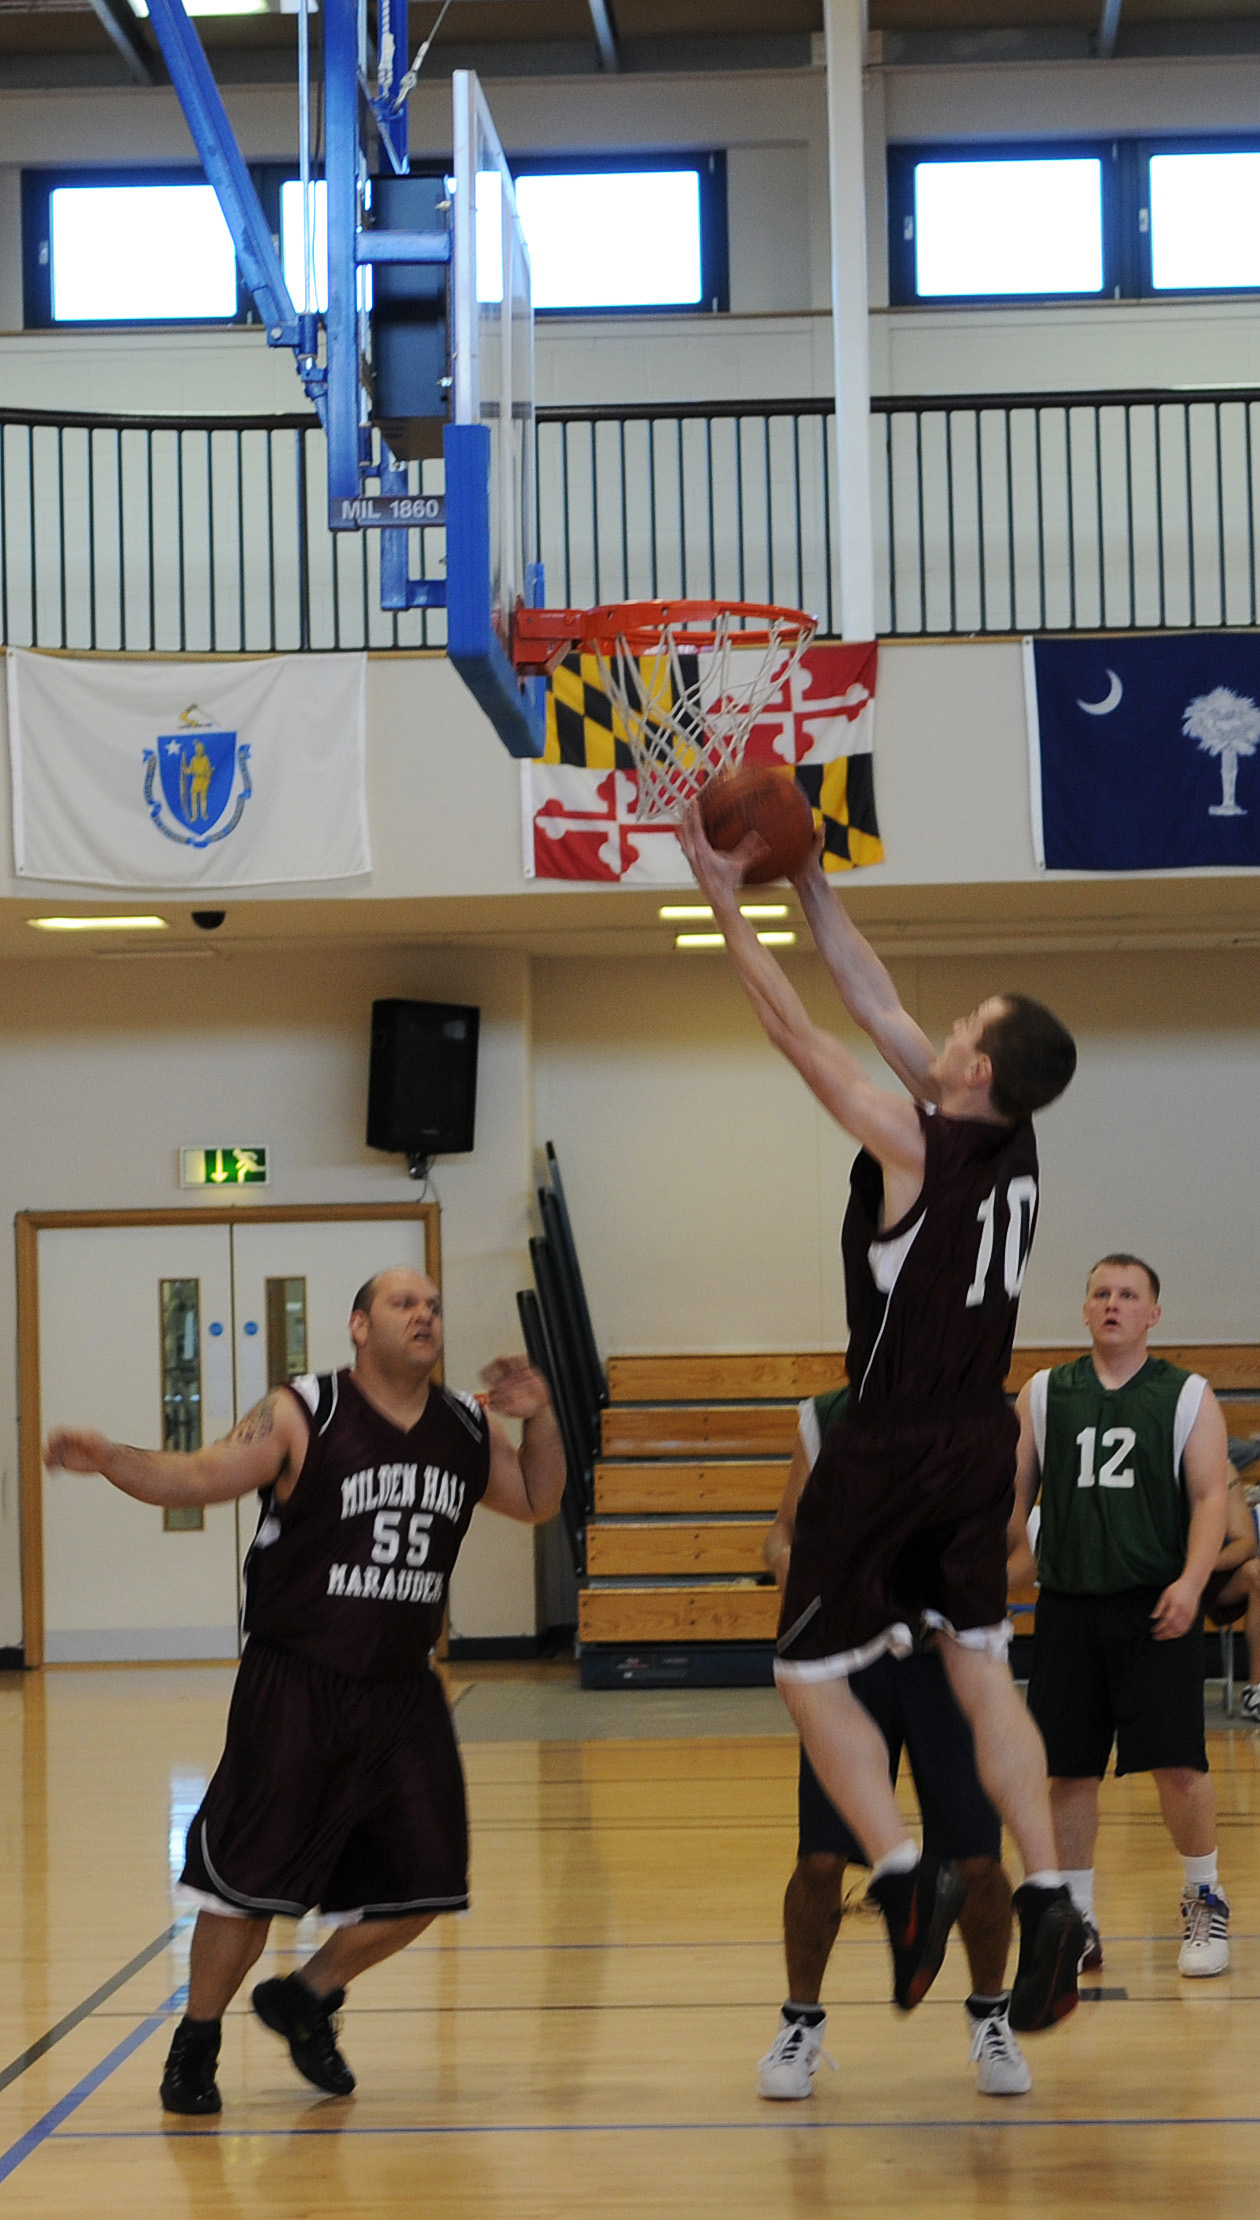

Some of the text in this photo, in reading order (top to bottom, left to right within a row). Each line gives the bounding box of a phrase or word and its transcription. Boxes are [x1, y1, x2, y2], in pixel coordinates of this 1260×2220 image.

[342, 498, 440, 520] MIL 1860
[965, 1174, 1038, 1308] 10
[1076, 1426, 1136, 1489] 12
[371, 1510, 434, 1567] 55
